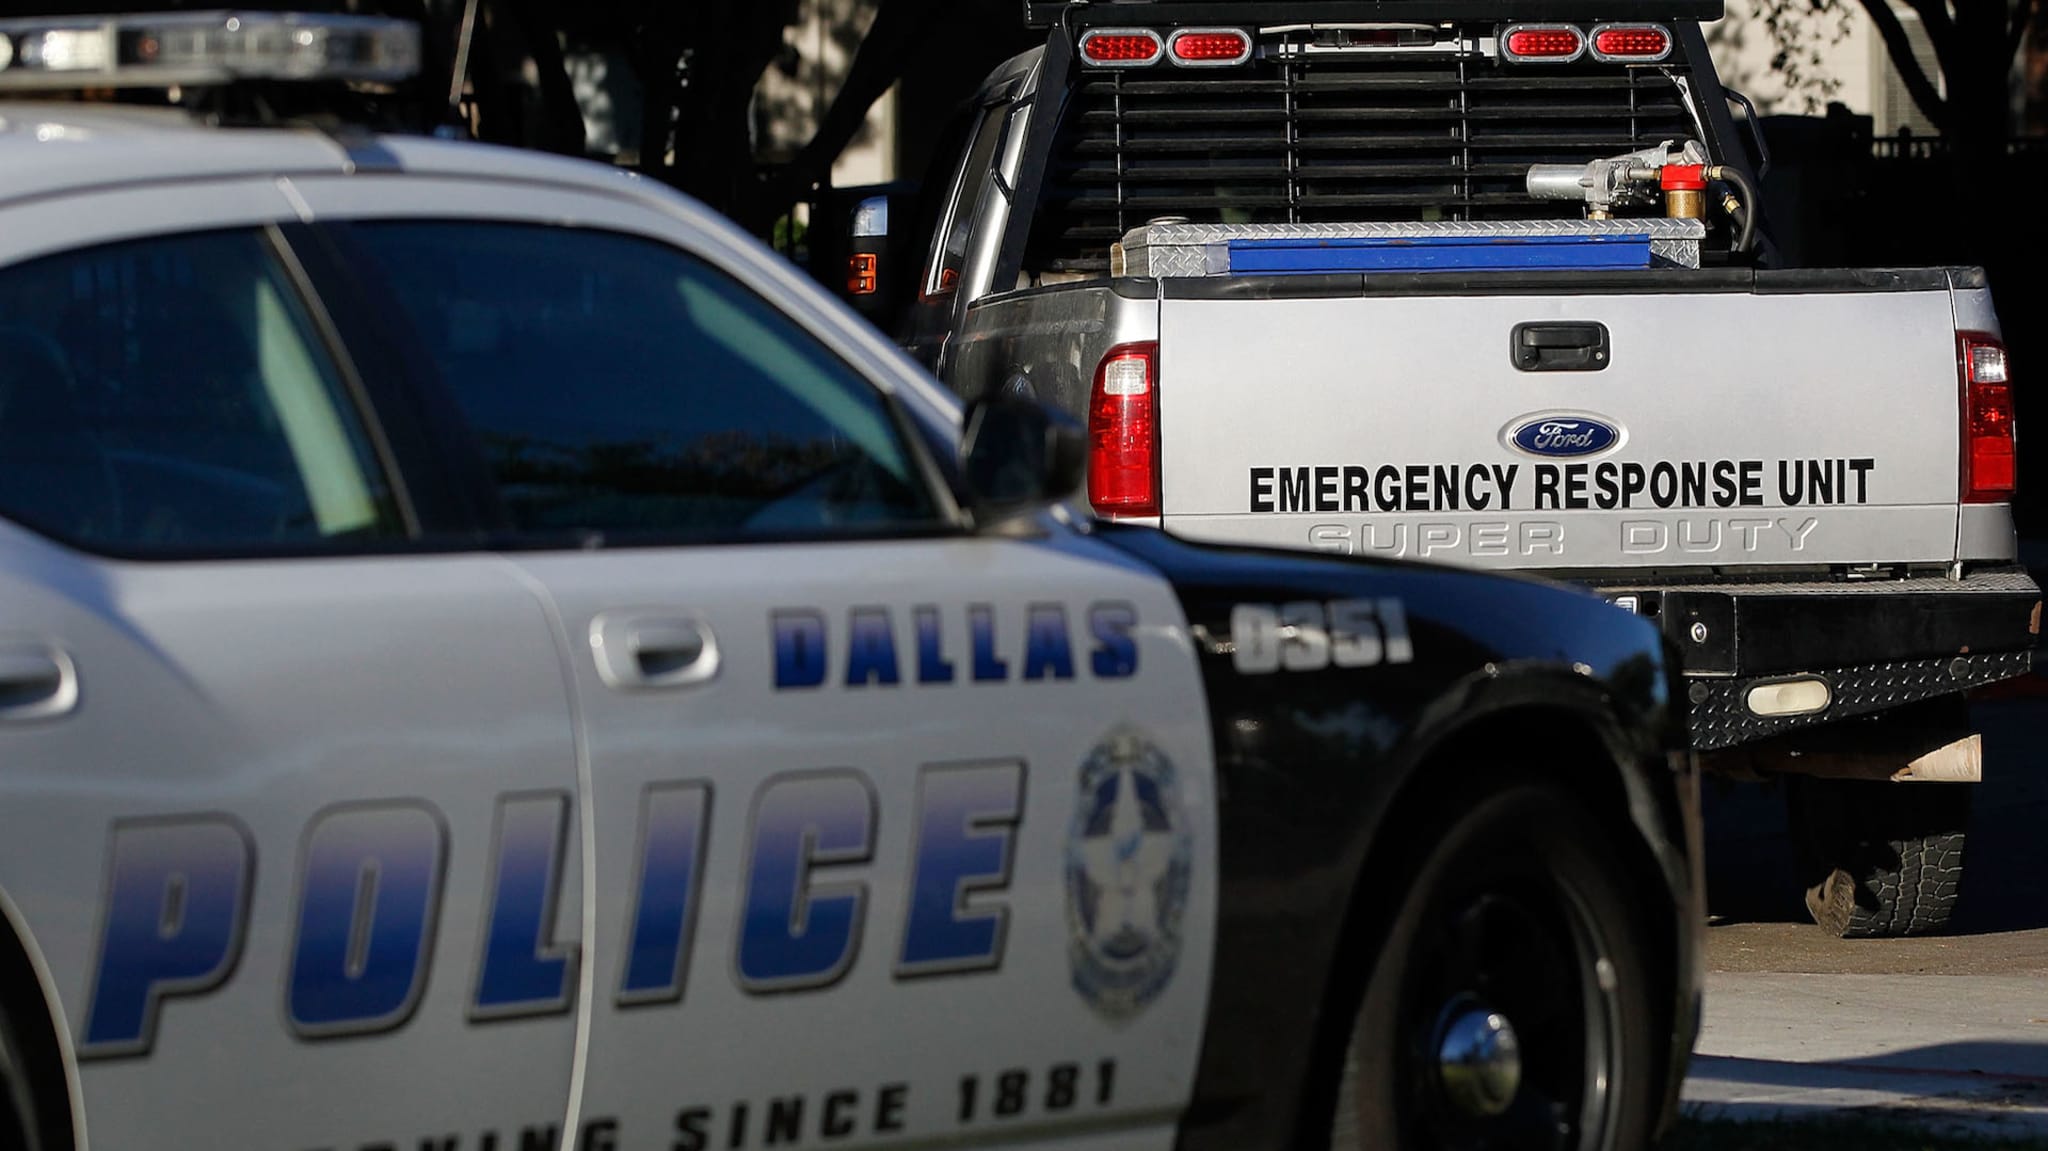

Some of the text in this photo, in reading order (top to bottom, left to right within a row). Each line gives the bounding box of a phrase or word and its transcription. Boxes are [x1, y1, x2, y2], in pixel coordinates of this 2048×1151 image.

[1534, 422, 1594, 449] Ford
[1250, 458, 1874, 512] EMERGENCY RESPONSE UNIT
[1308, 517, 1818, 558] SUPER DUTY
[770, 604, 1139, 690] DALLAS
[1231, 598, 1413, 674] 0351
[78, 758, 1028, 1060] POLICE
[674, 1082, 908, 1151] SINCE
[959, 1059, 1115, 1123] 1881
